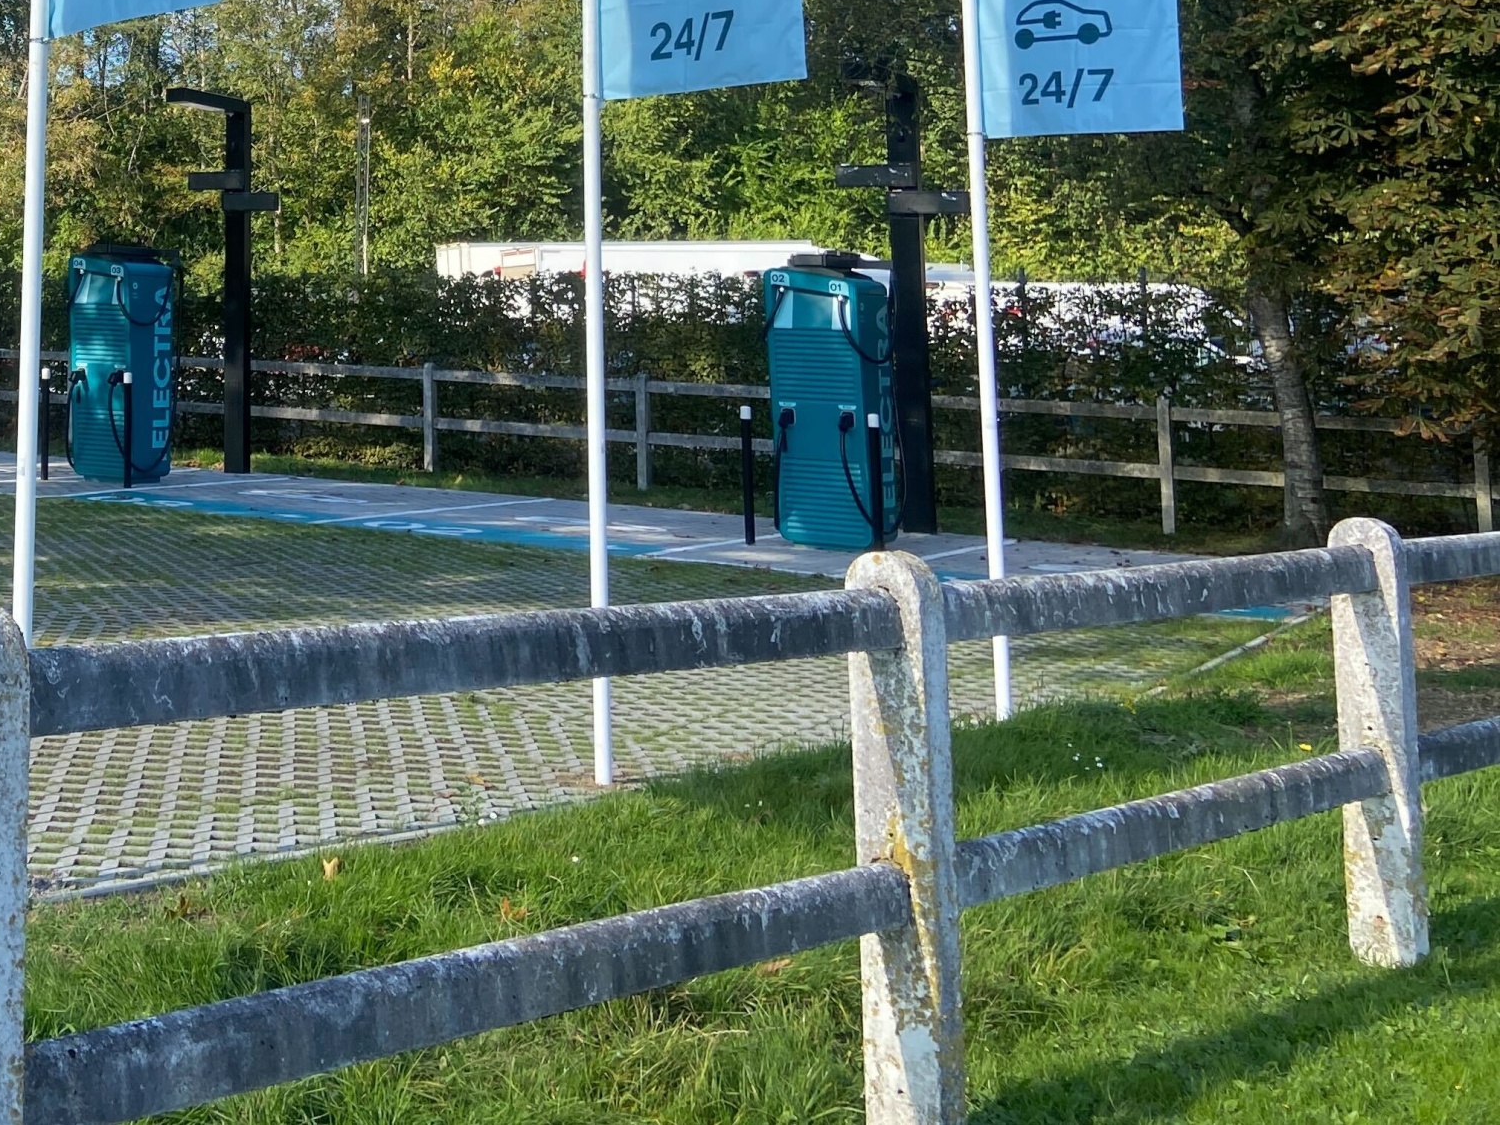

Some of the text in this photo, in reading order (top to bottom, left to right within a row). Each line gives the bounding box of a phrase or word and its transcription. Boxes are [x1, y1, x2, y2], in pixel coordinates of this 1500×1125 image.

[649, 10, 736, 64] 24/7
[1018, 68, 1115, 109] 24/7
[73, 259, 83, 267] 04
[111, 266, 121, 274] 03
[771, 274, 785, 283] 02
[830, 283, 842, 292] 01
[151, 285, 172, 449] ELECTRA
